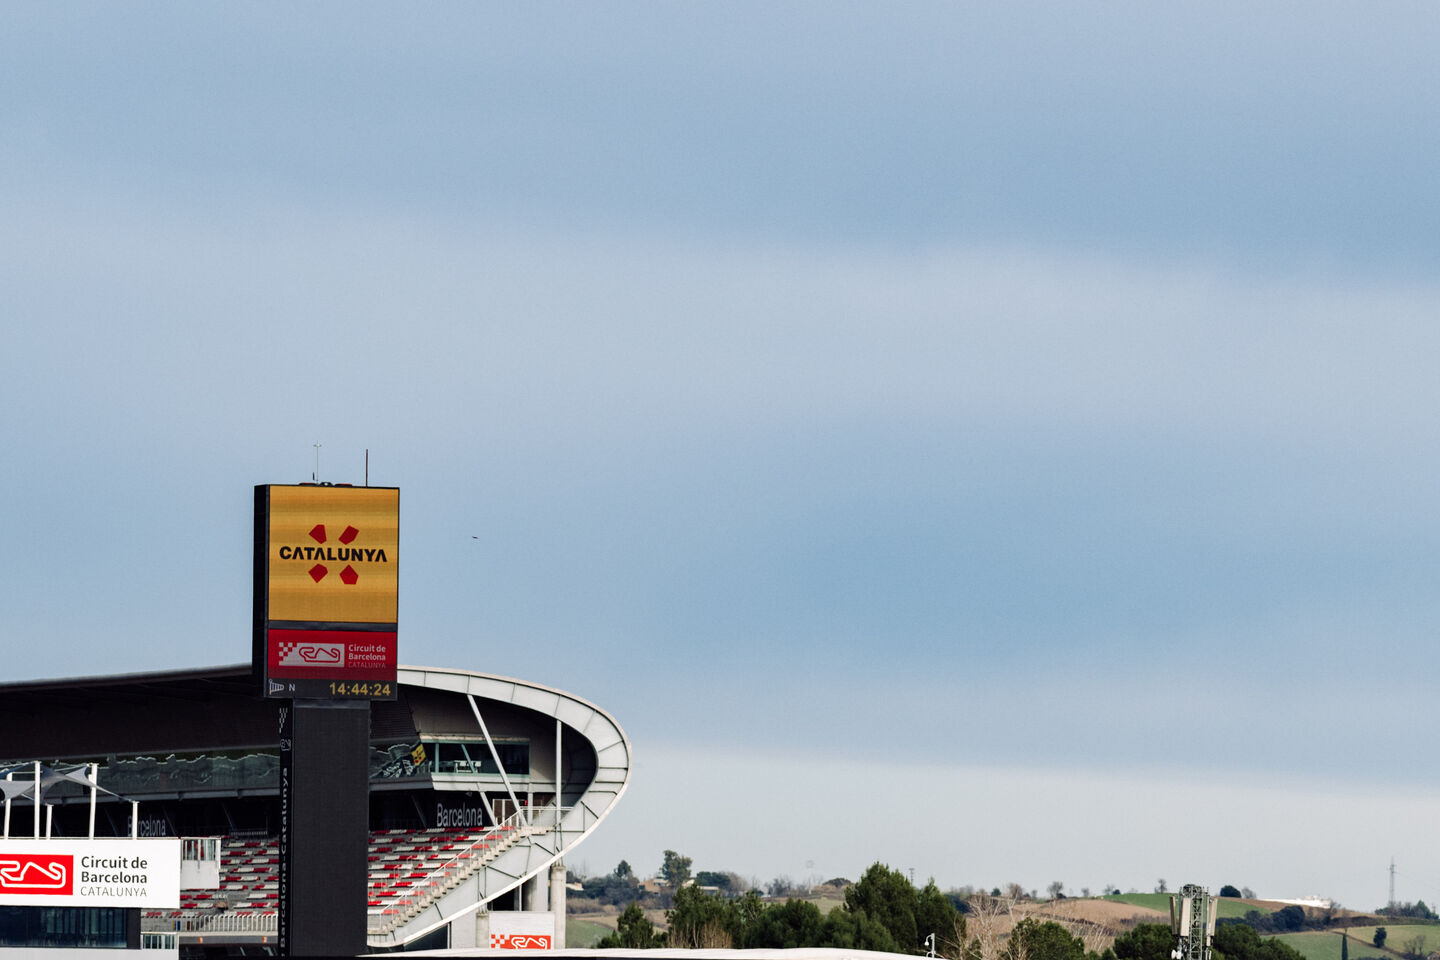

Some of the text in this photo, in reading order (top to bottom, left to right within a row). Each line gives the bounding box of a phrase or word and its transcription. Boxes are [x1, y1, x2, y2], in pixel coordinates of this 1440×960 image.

[279, 546, 388, 562] CATALUNYA
[348, 644, 386, 653] Circuit de
[348, 652, 386, 660] Barcelona
[289, 683, 391, 696] N 14:44:24
[436, 802, 483, 827] Barcelona
[128, 815, 166, 837] Brcelona
[81, 856, 148, 869] Circuit de
[81, 871, 147, 883] Barcelona
[80, 886, 147, 897] CATALUNYA
